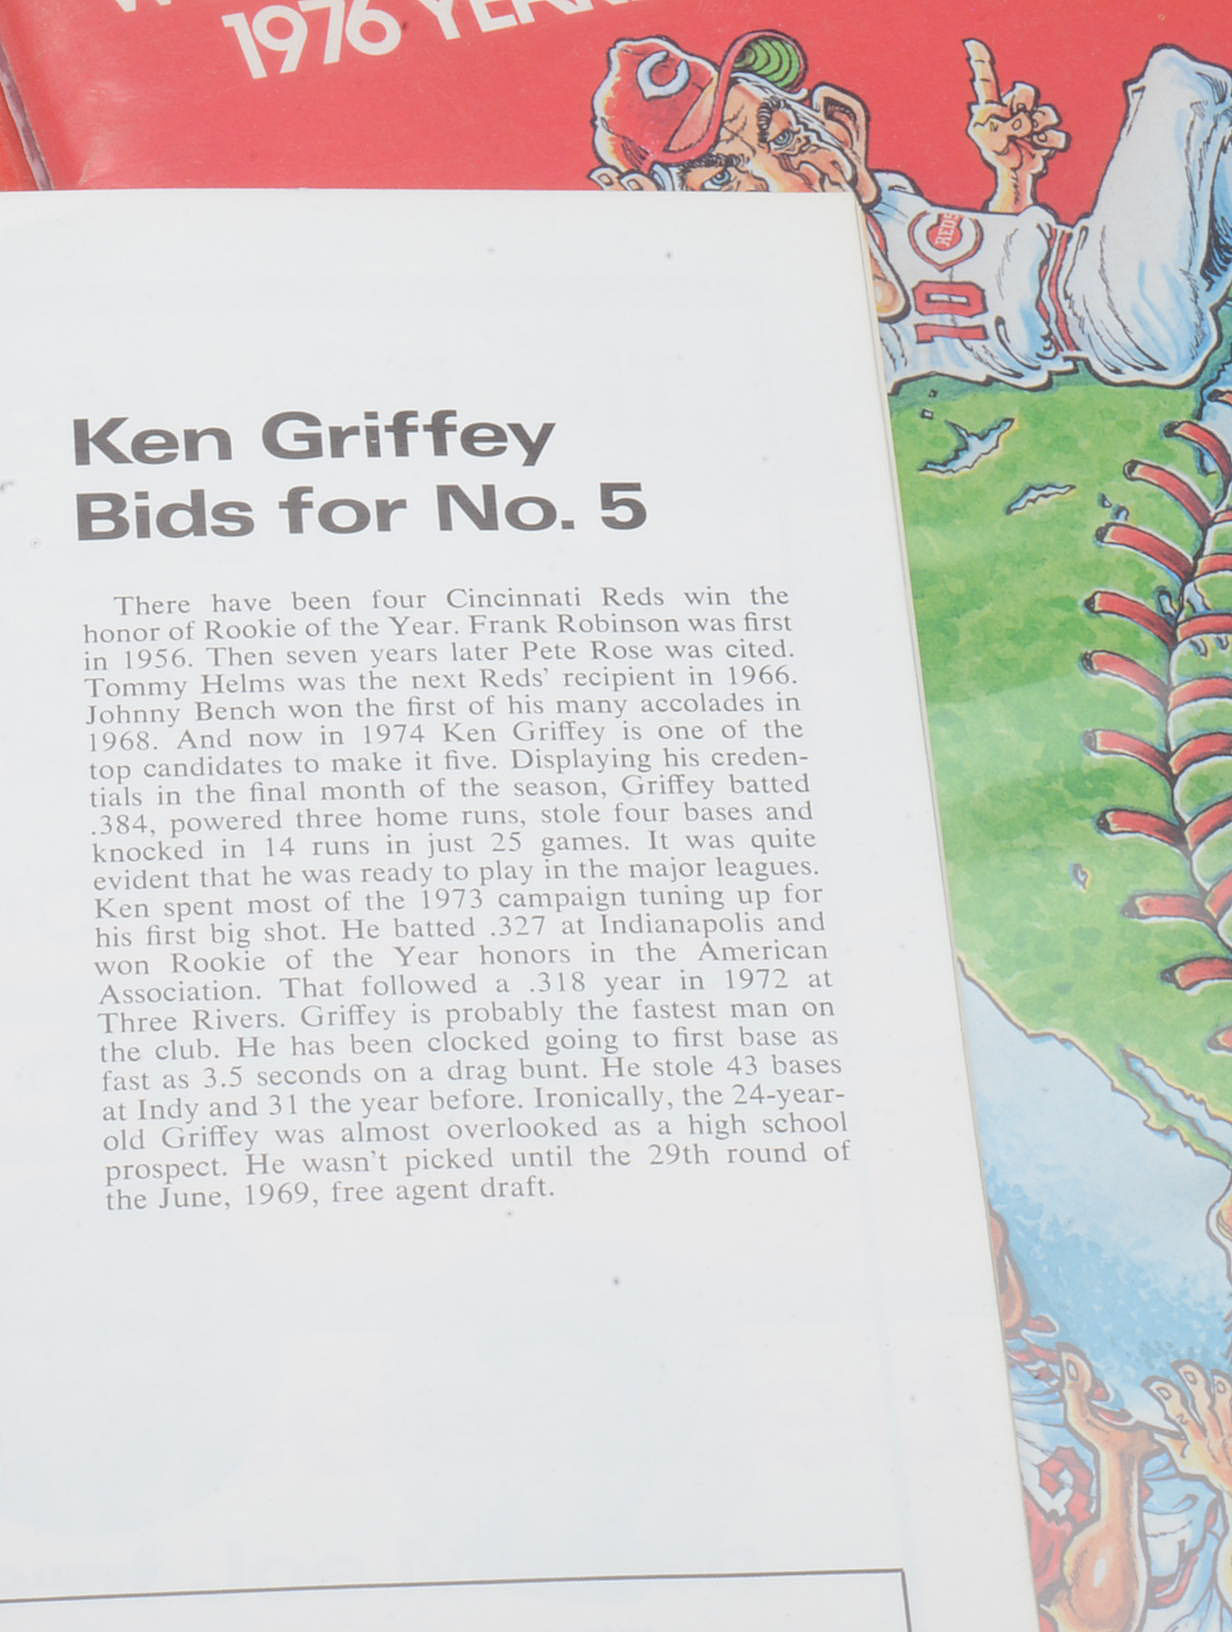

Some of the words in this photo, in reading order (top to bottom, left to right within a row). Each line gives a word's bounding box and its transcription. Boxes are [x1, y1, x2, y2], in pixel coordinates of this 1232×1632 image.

[221, 0, 402, 79] 1976
[72, 416, 232, 466] Ken
[261, 409, 557, 467] Griffey
[76, 489, 255, 541] Bids
[279, 486, 407, 534] for
[436, 484, 575, 532] No.
[599, 482, 648, 530] 5
[112, 595, 191, 616] There
[212, 592, 272, 613] have
[290, 590, 351, 611] been
[372, 588, 427, 609] four
[446, 586, 581, 609] Cincinnati
[601, 586, 665, 607] Reds
[683, 585, 731, 606] win
[750, 585, 789, 606] the
[84, 650, 108, 672] in
[125, 647, 193, 670] 1956.
[205, 646, 273, 667] Then
[286, 649, 357, 665] seven
[370, 647, 438, 669] years
[451, 641, 509, 662] later
[522, 640, 577, 661] Pete
[590, 640, 654, 660] Rose
[664, 644, 714, 659] was
[725, 637, 795, 659] cited.
[89, 763, 132, 785] top
[143, 755, 283, 778] candidates
[294, 756, 320, 774] to
[331, 751, 402, 773] make
[415, 750, 433, 771] it
[444, 749, 497, 771] five.
[511, 747, 652, 775] Displaying
[662, 746, 700, 768] his
[711, 745, 809, 767] creden-
[91, 813, 156, 836] .384,
[170, 808, 282, 839] powered
[295, 807, 362, 829] three
[375, 806, 449, 827] home
[461, 809, 526, 827] runs,
[540, 802, 601, 824] stole
[614, 801, 670, 823] four
[683, 801, 753, 822] bases
[766, 799, 813, 821] and
[94, 897, 150, 919] Ken
[163, 897, 233, 923] spent
[247, 895, 311, 915] most
[324, 890, 352, 912] of
[365, 889, 405, 911] the
[423, 887, 483, 910] 1973
[498, 885, 627, 913] campaign
[639, 884, 725, 911] tuning
[737, 889, 771, 911] up
[783, 882, 824, 904] for
[96, 1011, 177, 1034] Three
[191, 1008, 285, 1031] Rivers.
[300, 1003, 396, 1031] Griffey
[411, 1002, 431, 1025] is
[445, 1000, 564, 1030] probably
[577, 999, 619, 1021] the
[632, 997, 717, 1020] fastest
[730, 1002, 788, 1019] man
[801, 1001, 835, 1017] on
[102, 1103, 127, 1122] at
[137, 1097, 199, 1125] Indy
[209, 1095, 258, 1118] and
[269, 1093, 297, 1116] 31
[310, 1092, 352, 1115] the
[360, 1095, 419, 1119] year
[429, 1088, 523, 1111] before.
[534, 1084, 673, 1113] Ironically,
[682, 1083, 724, 1107] the
[732, 1083, 845, 1111] 24-year-
[106, 1188, 147, 1211] the
[158, 1186, 231, 1210] June,
[247, 1181, 319, 1208] 1969,
[332, 1180, 384, 1203] free
[396, 1180, 469, 1207] agent
[480, 1174, 555, 1199] draft.
